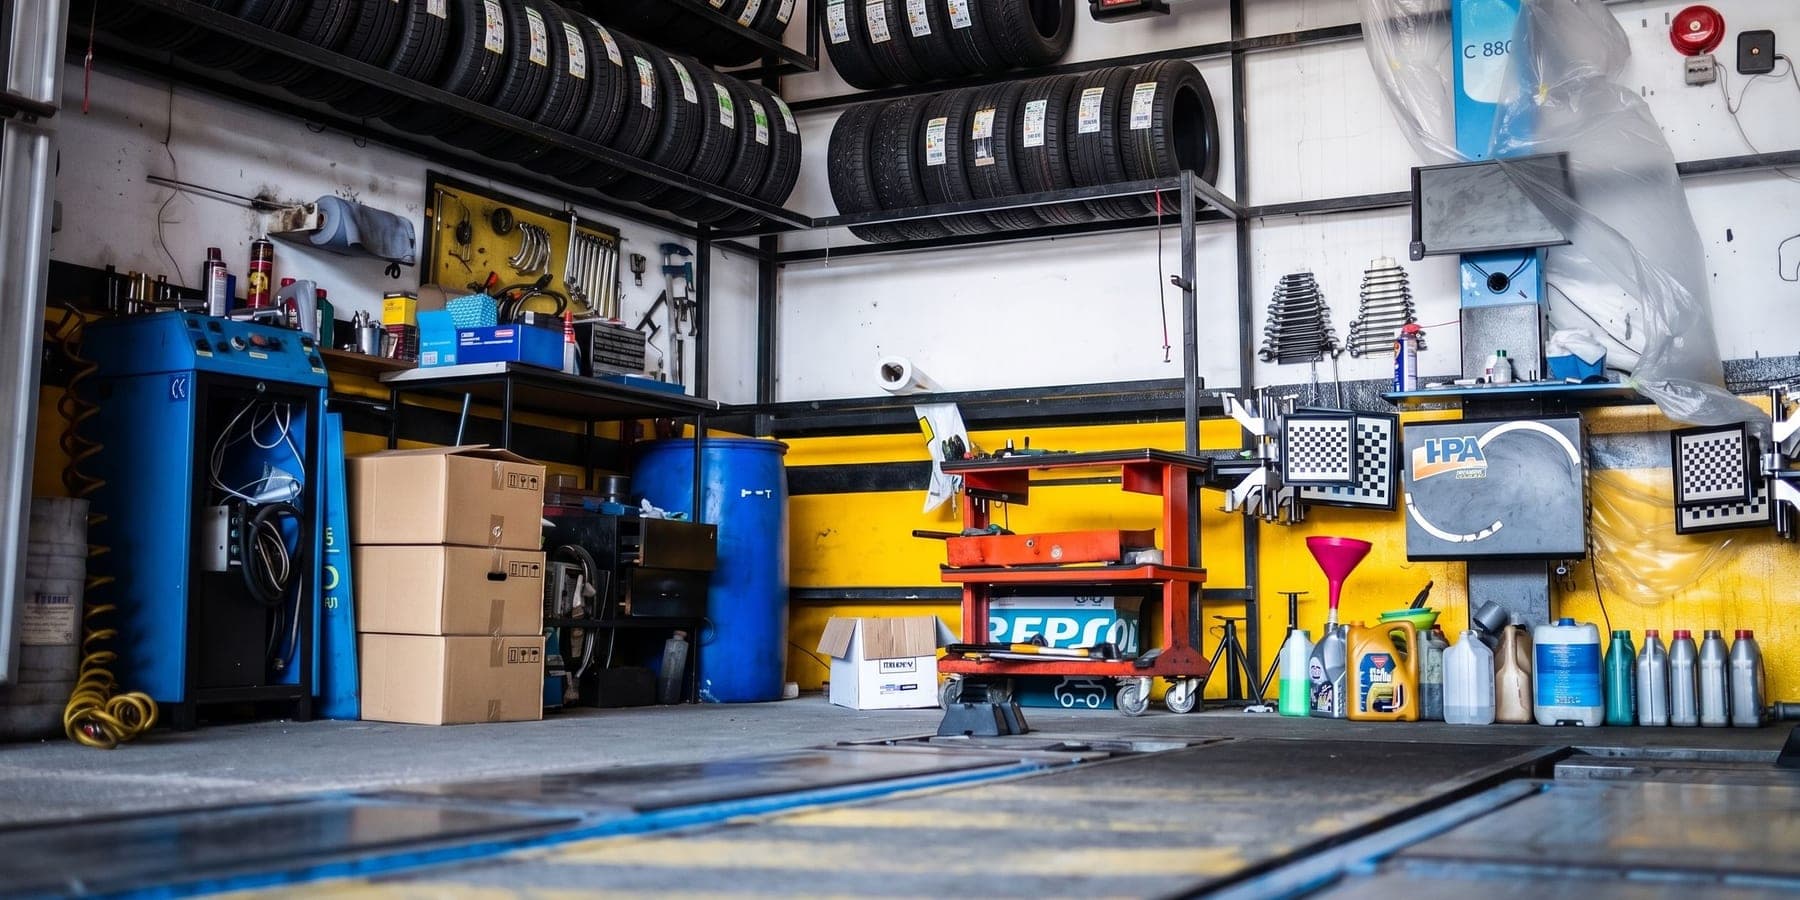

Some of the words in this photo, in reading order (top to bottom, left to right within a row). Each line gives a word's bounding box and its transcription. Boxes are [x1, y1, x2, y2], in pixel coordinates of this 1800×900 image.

[1464, 44, 1476, 59] C
[1425, 436, 1486, 464] HPA
[989, 616, 1138, 653] REPSOL
